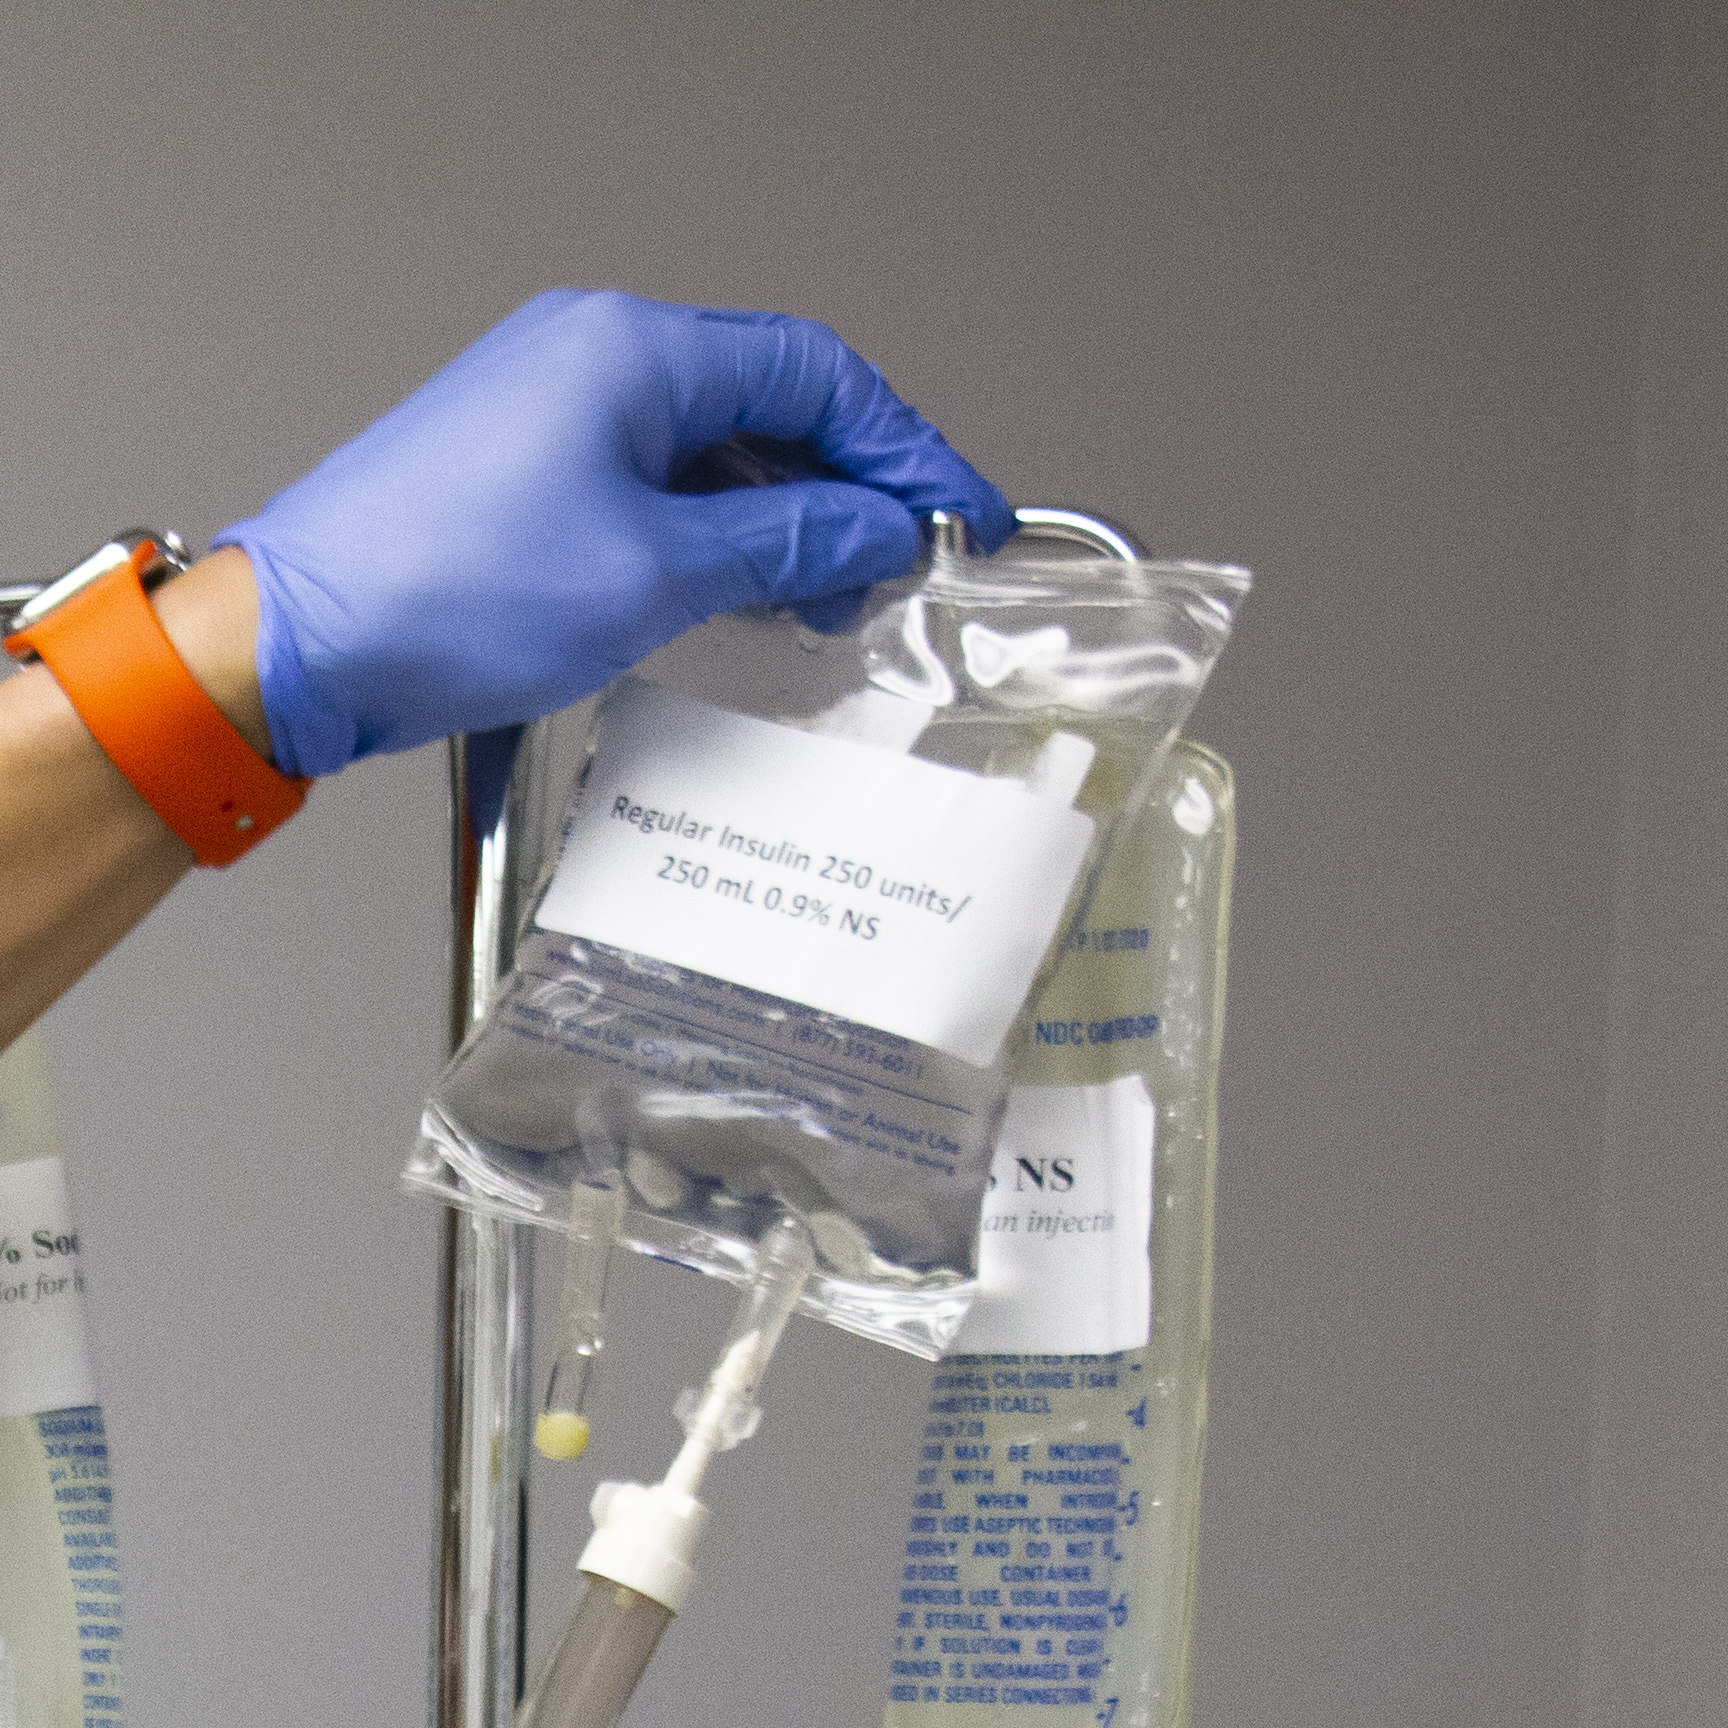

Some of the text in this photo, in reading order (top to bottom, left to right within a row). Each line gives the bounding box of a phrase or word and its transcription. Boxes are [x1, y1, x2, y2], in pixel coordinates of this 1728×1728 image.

[610, 795, 713, 842] Regular
[718, 825, 812, 872] Insulin
[819, 855, 873, 890] 250
[879, 877, 973, 924] units/
[656, 855, 881, 941] 250 mL 0.9% NS
[1035, 1020, 1084, 1046] NDC
[1016, 1156, 1074, 1192] NS
[34, 1274, 69, 1304] for
[954, 1445, 991, 1461] MAY
[1008, 1445, 1031, 1462] BE
[952, 1468, 995, 1485] WITH
[975, 1493, 1029, 1509] WHEN
[974, 1516, 1042, 1534] ASEPTIC
[973, 1541, 1010, 1557] AND
